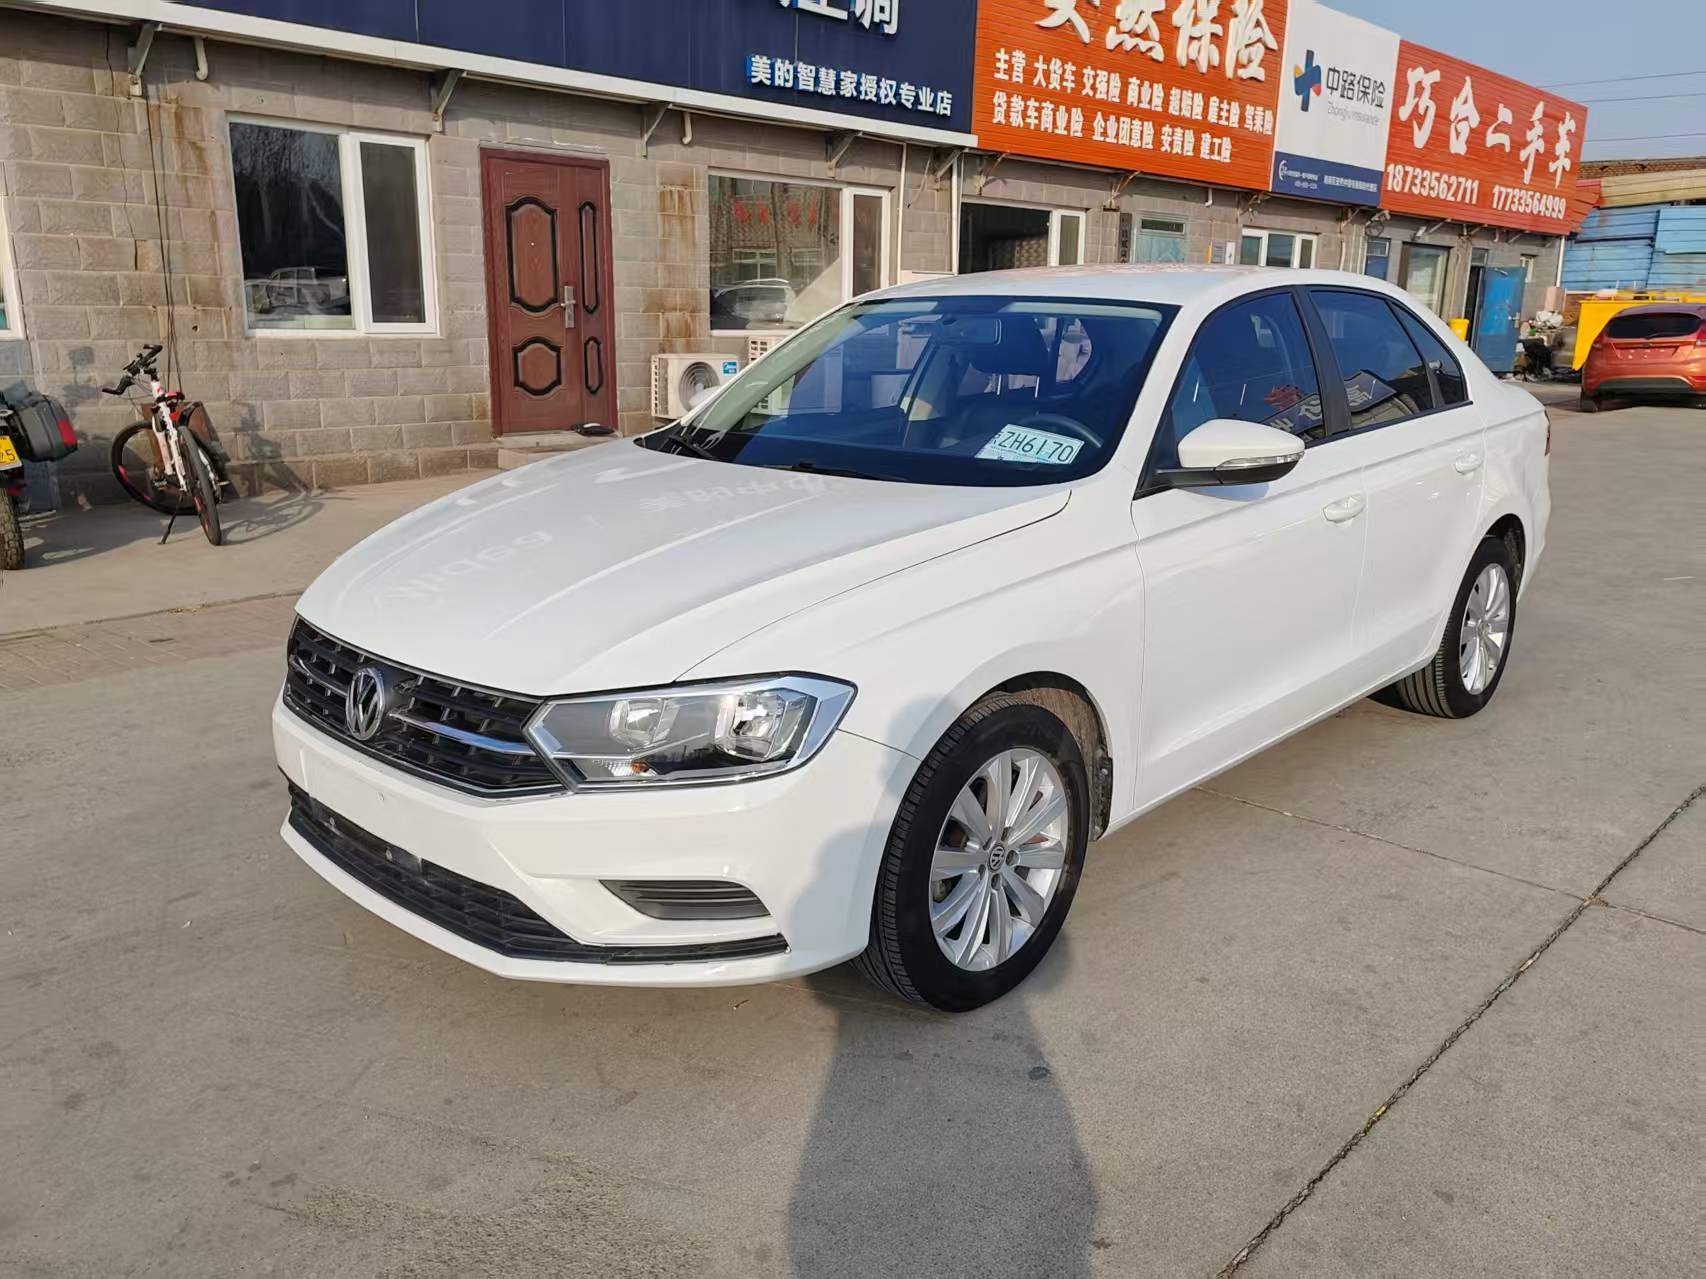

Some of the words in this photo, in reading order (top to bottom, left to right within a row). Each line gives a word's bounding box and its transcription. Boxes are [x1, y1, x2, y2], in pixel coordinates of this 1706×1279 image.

[751, 55, 952, 117] 美的智慧家授权专业店
[994, 48, 1025, 84] 主营
[1033, 55, 1076, 94] 大货车
[1082, 66, 1121, 103] 交强险
[1127, 77, 1165, 112] 商业险
[1208, 95, 1240, 129] 雇主险
[1244, 103, 1274, 136] 驾乘险
[1326, 66, 1387, 109] 中路保险
[992, 91, 1084, 138] 贷款车商业险
[1093, 111, 1155, 150] 企业团意险
[1160, 124, 1196, 157] 安责险
[1200, 132, 1232, 164] 建工险
[1386, 163, 1480, 205] 18733562711
[1492, 184, 1567, 220] 17733564999
